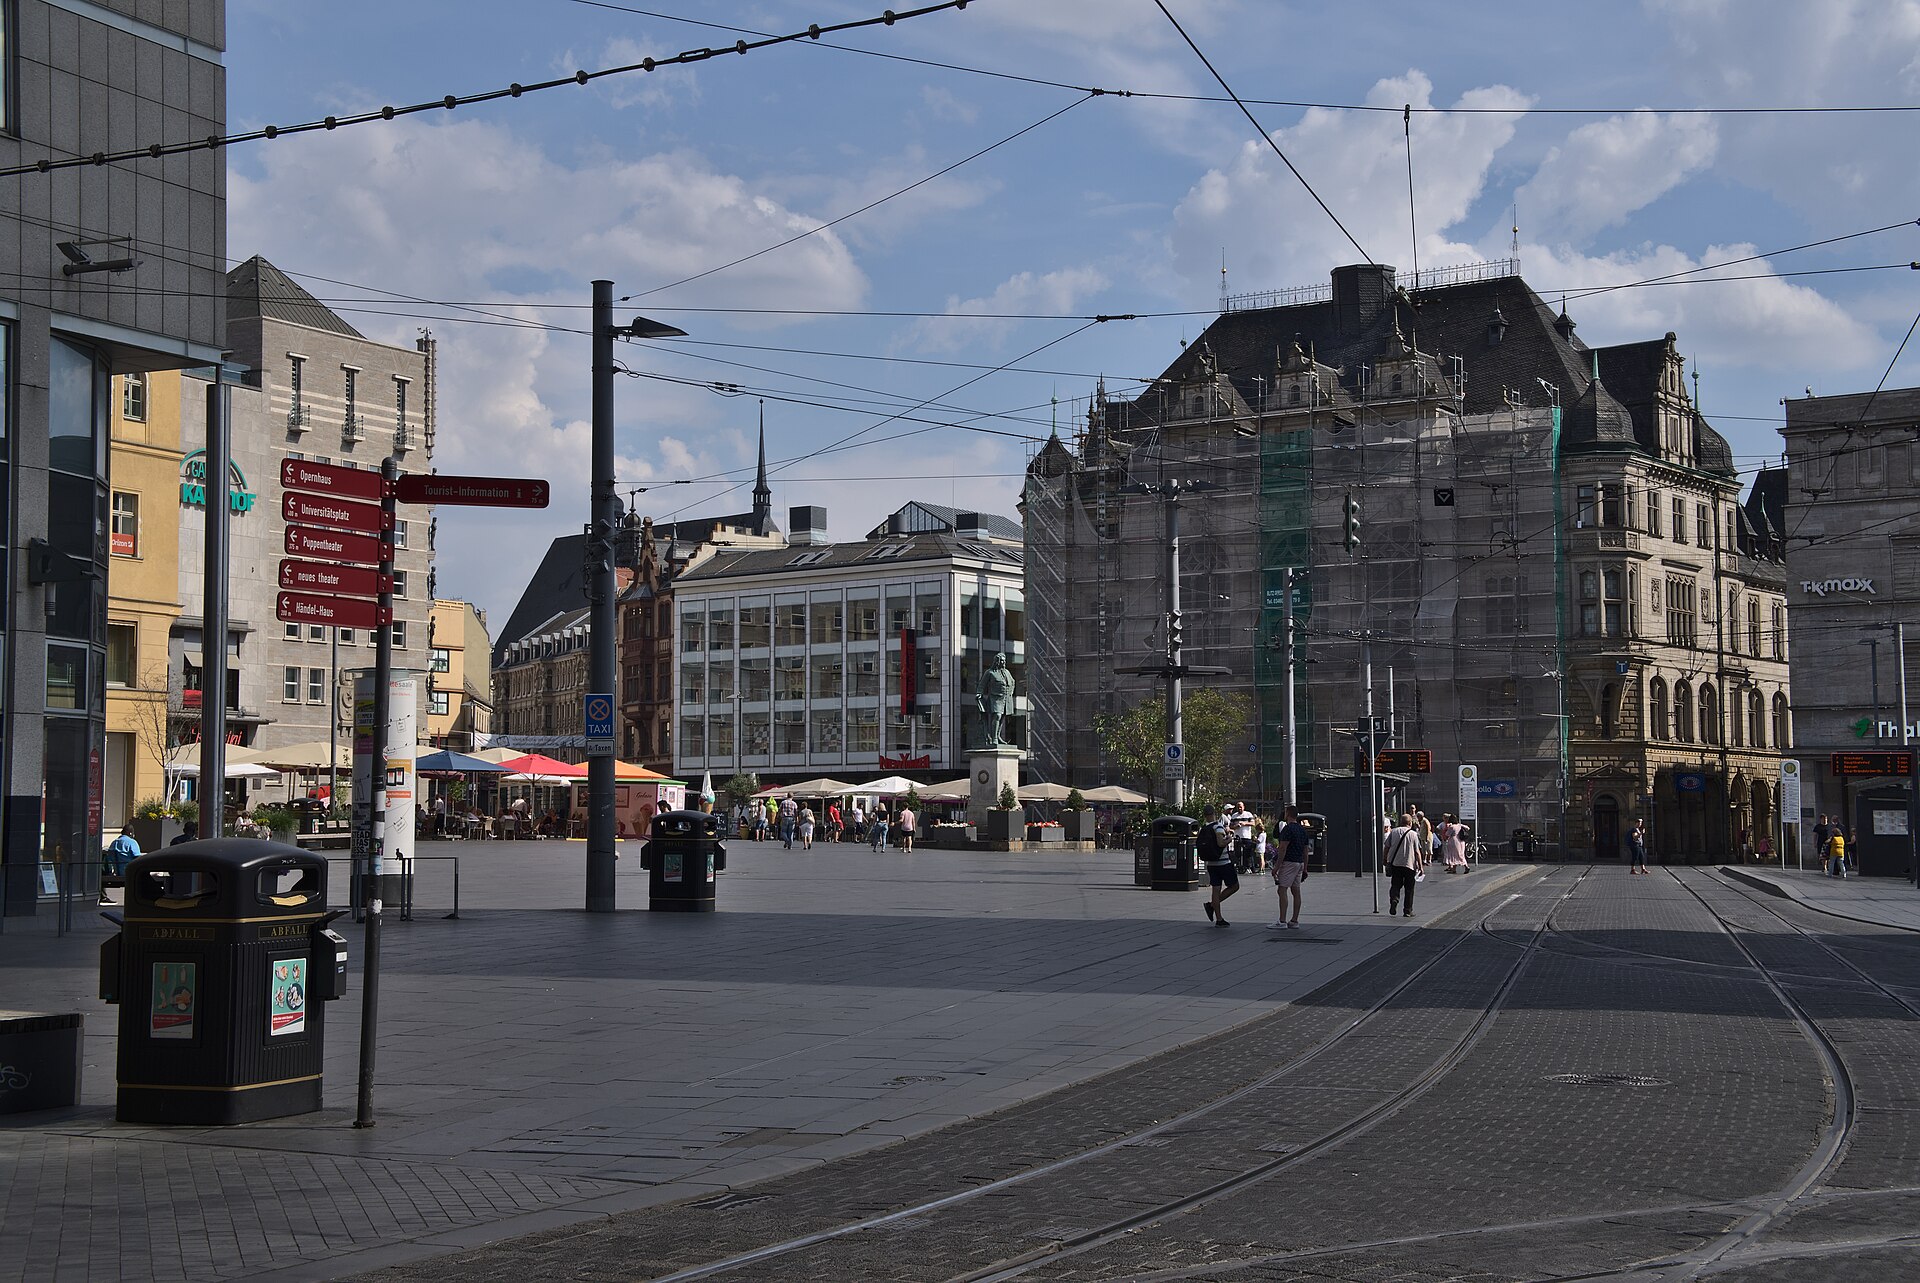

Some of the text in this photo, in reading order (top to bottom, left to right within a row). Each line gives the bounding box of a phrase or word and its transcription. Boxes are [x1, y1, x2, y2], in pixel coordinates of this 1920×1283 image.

[300, 469, 332, 485] Opernhaus
[424, 484, 509, 498] Tourist-Information
[301, 504, 349, 521] Universitätsplatz
[303, 536, 343, 552] Puppentheater
[298, 572, 339, 585] neues theater
[296, 602, 333, 617] Händel-Haus
[588, 724, 611, 734] TAXI
[152, 929, 200, 938] ABFALL
[270, 925, 308, 937] ABFALL
